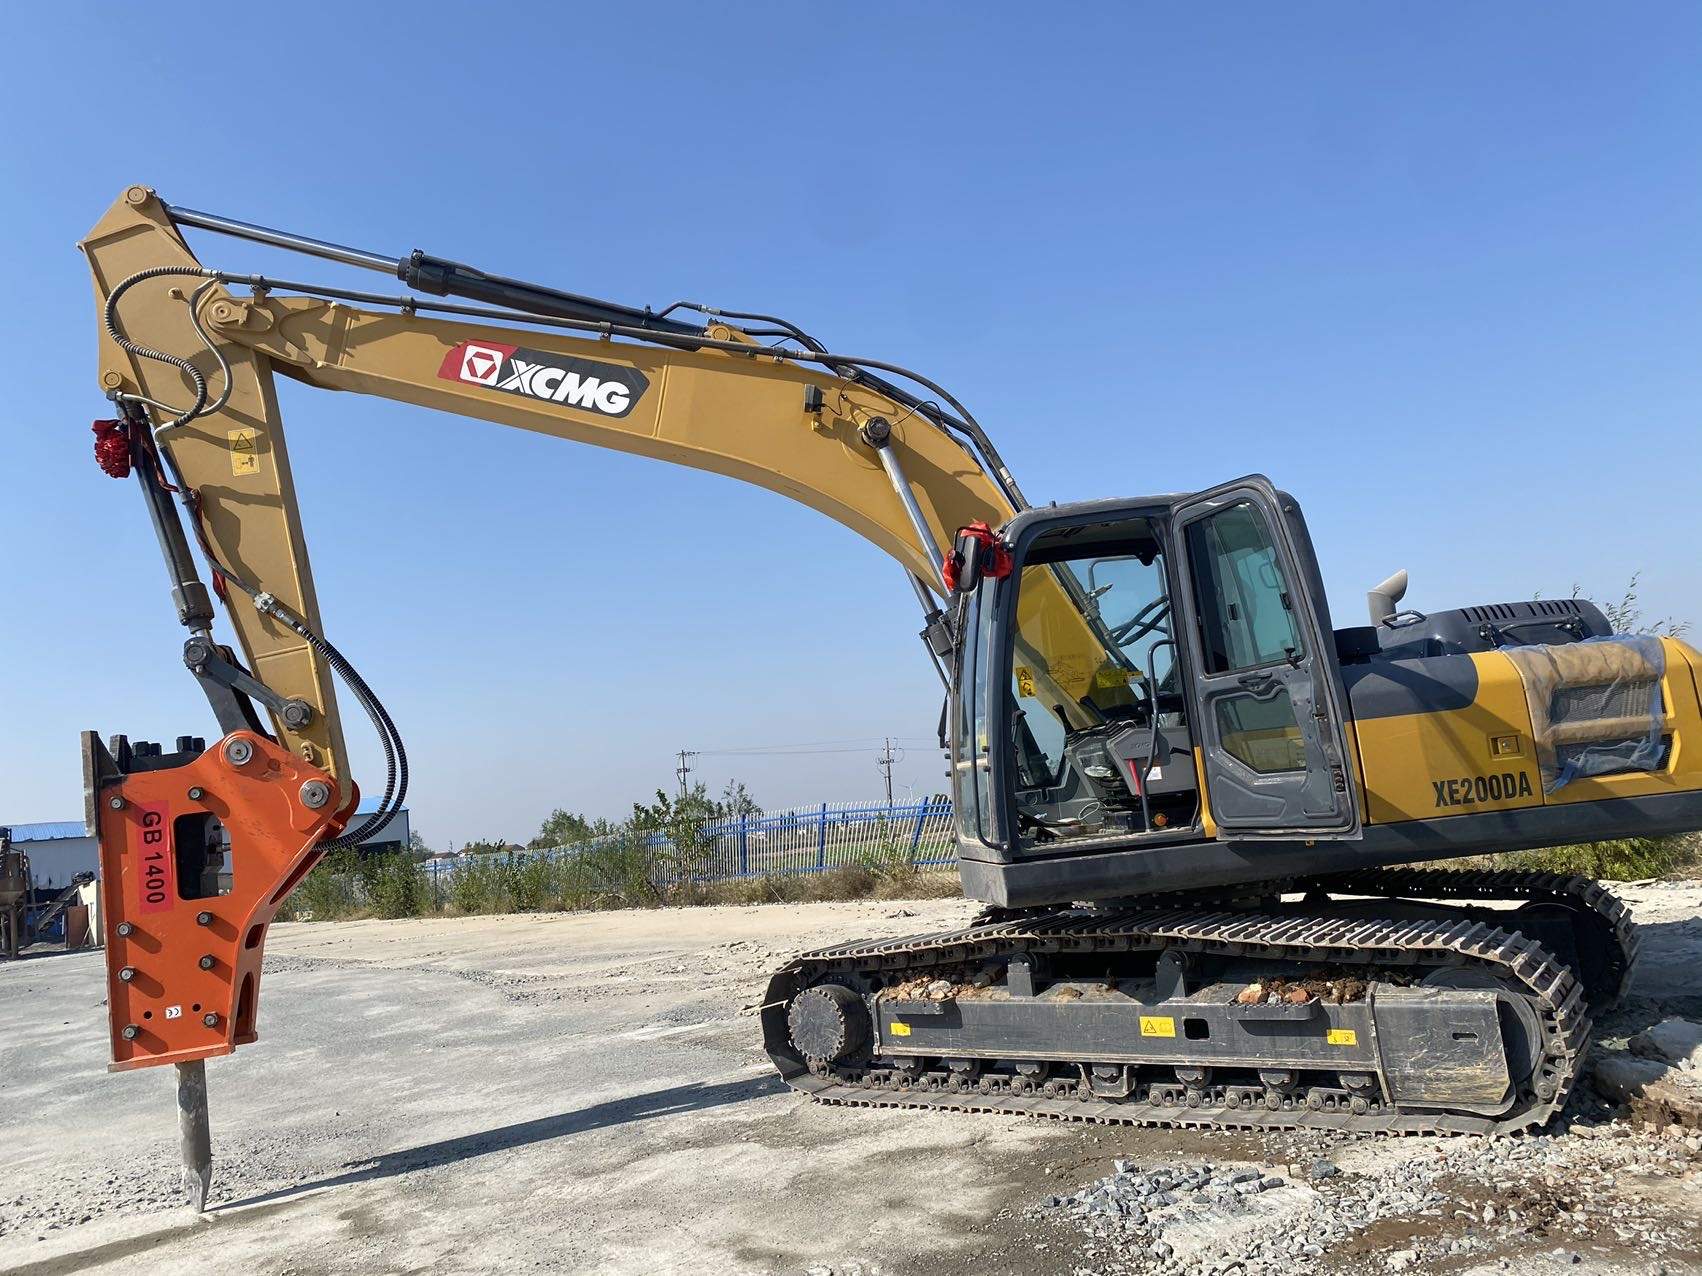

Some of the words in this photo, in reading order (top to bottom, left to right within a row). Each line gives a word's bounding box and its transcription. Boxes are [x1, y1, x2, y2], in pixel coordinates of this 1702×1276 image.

[495, 358, 631, 415] XCMG
[1431, 771, 1533, 808] XE200DA
[142, 811, 162, 845] GB
[144, 852, 166, 904] 1400
